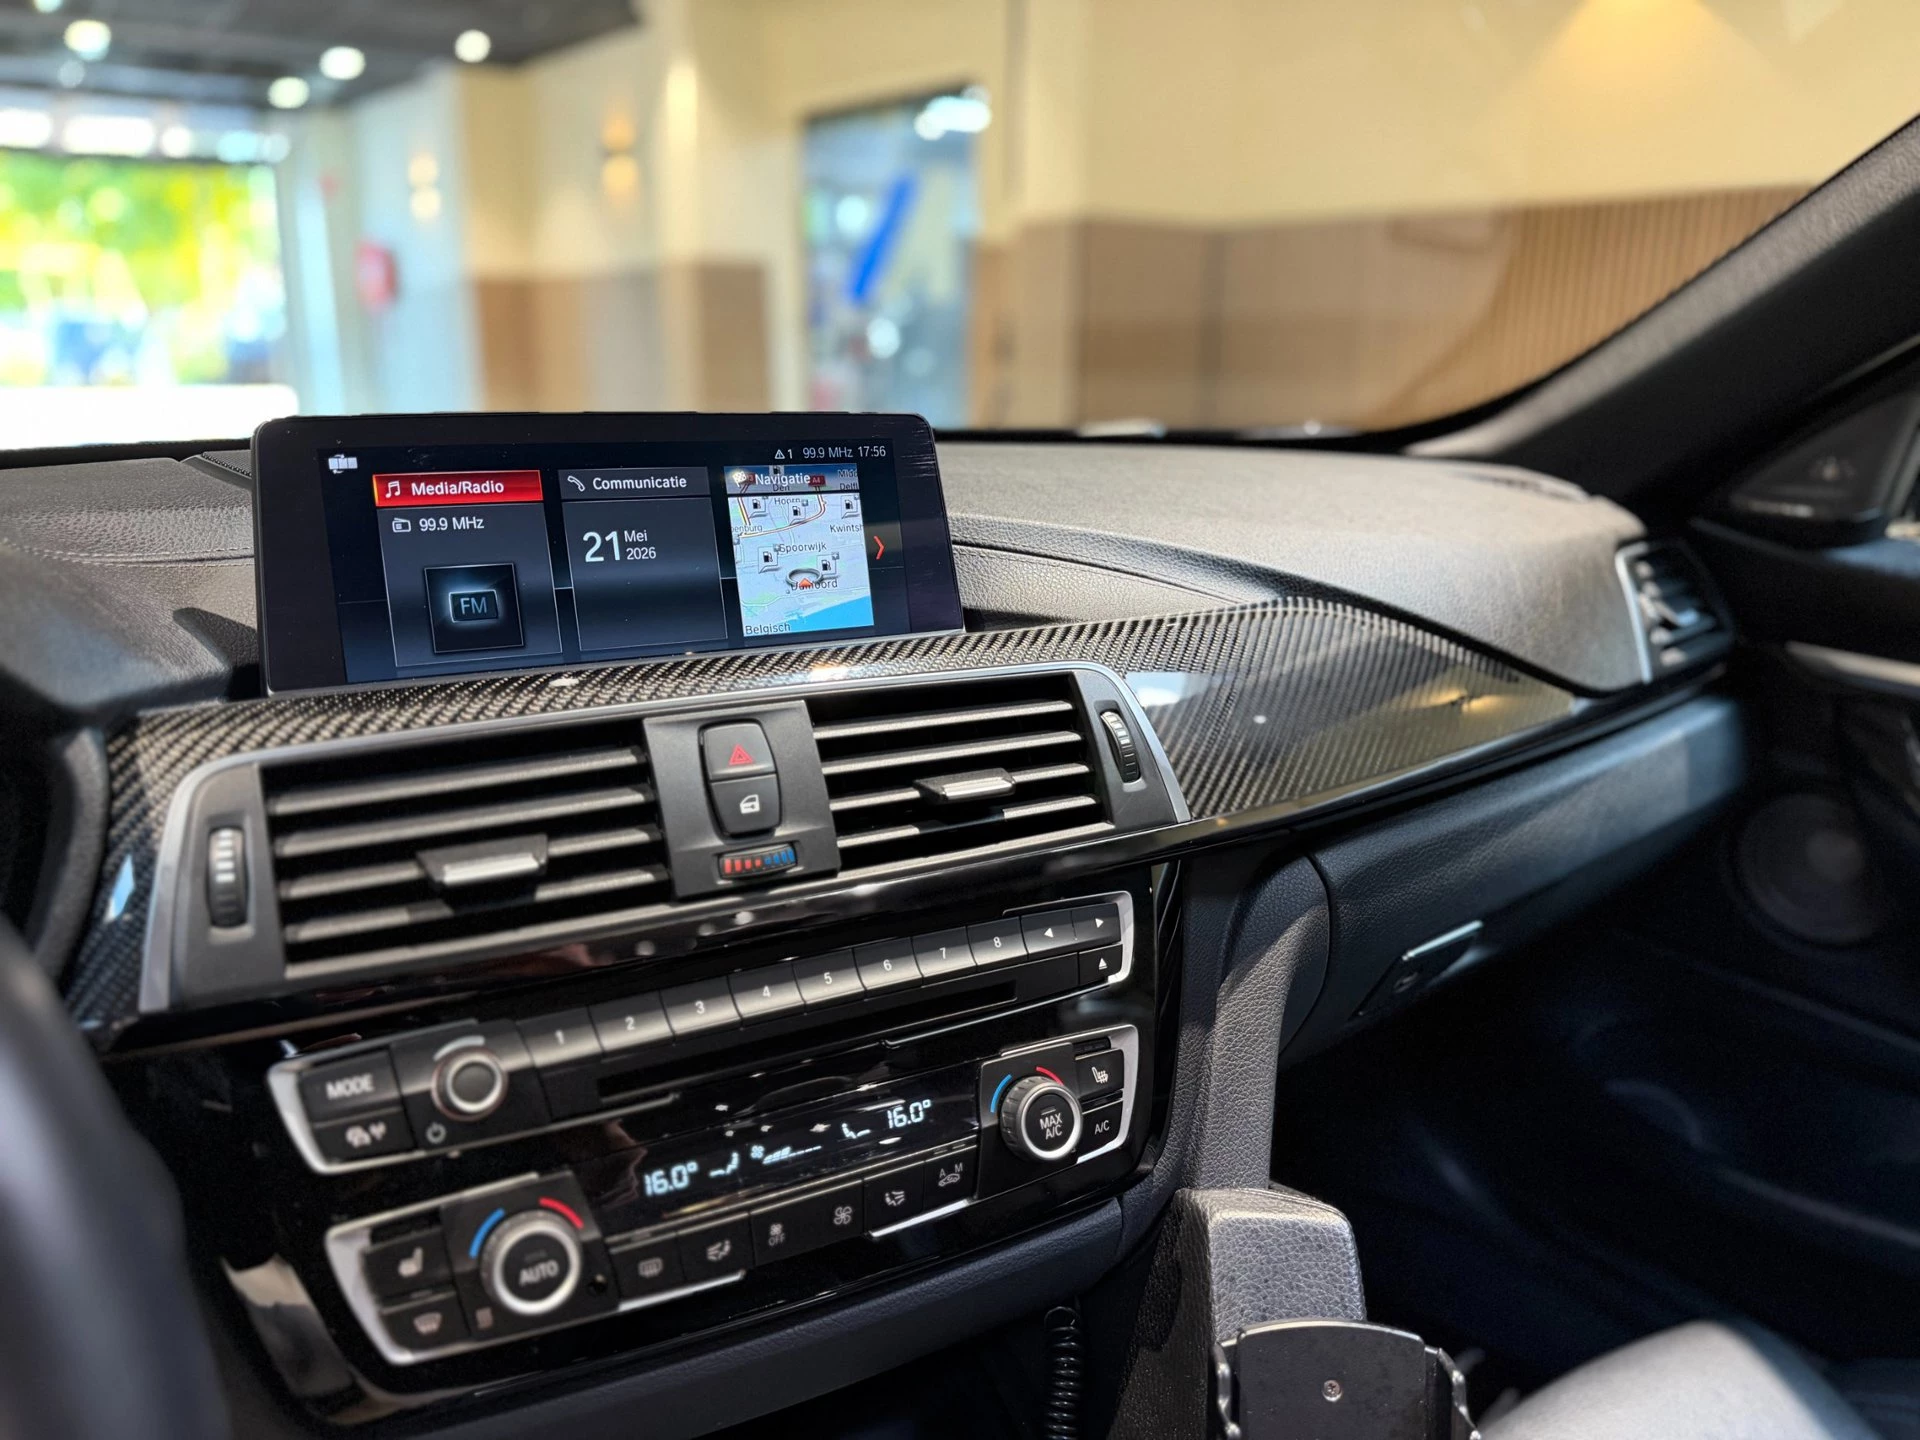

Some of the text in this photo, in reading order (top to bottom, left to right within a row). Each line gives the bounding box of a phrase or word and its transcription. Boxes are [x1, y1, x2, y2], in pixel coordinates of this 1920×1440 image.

[788, 445, 886, 459] 1 99.9 MHz 17:56
[592, 476, 687, 490] Communicatie
[755, 472, 811, 487] Navigatie
[411, 481, 504, 496] Media/Radio
[419, 516, 485, 532] 99.9 MHz
[624, 530, 648, 542] Mei
[582, 531, 621, 563] 21
[626, 547, 656, 560] 2026
[780, 541, 827, 553] Spoorwijk
[460, 597, 488, 615] FM
[745, 622, 791, 635] Belgisch
[993, 936, 1002, 949] 8
[939, 947, 947, 959] 7
[883, 959, 892, 972] 6
[823, 971, 832, 985] 5
[762, 985, 771, 998] 4
[694, 1000, 705, 1014] 3
[624, 1016, 635, 1031] 2
[555, 1030, 565, 1044] 1
[326, 1074, 374, 1100] MODE
[1039, 1112, 1063, 1130] MAX
[1094, 1120, 1110, 1135] A/C
[1045, 1124, 1063, 1140] A/C
[939, 1162, 963, 1179] A M
[768, 1232, 786, 1247] OFF
[519, 1260, 559, 1287] AUTO
